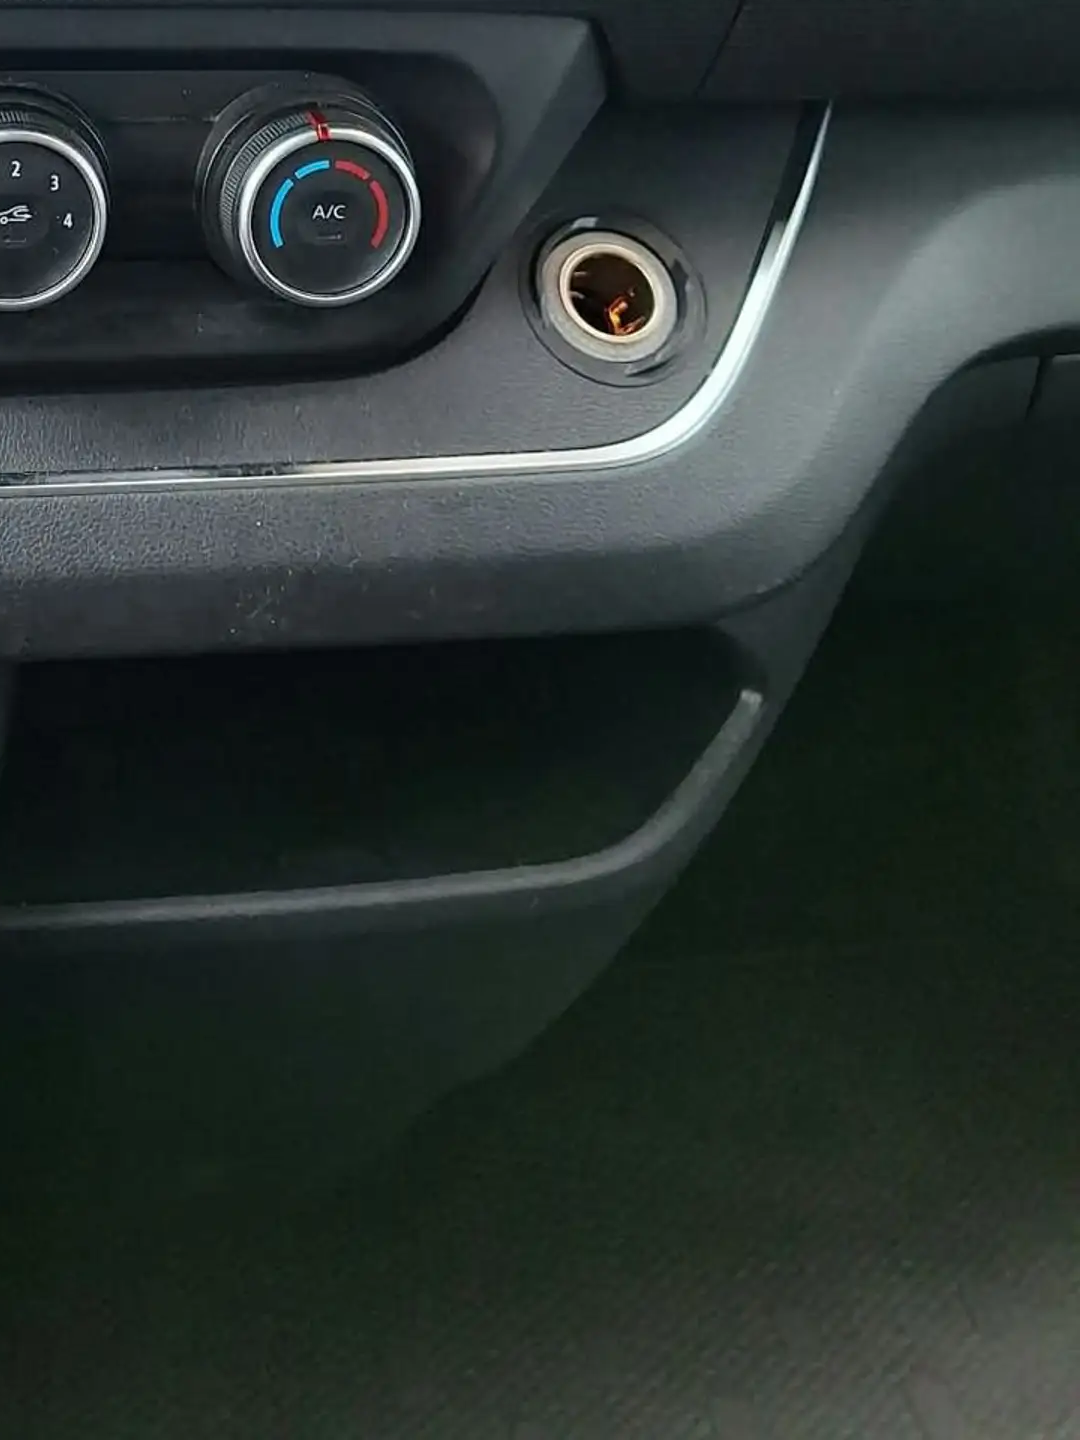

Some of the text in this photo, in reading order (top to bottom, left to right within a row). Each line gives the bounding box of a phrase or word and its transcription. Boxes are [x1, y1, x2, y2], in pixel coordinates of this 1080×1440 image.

[11, 160, 21, 178] 2
[50, 174, 60, 192] 3
[313, 204, 346, 219] A/C
[63, 213, 73, 229] 4
